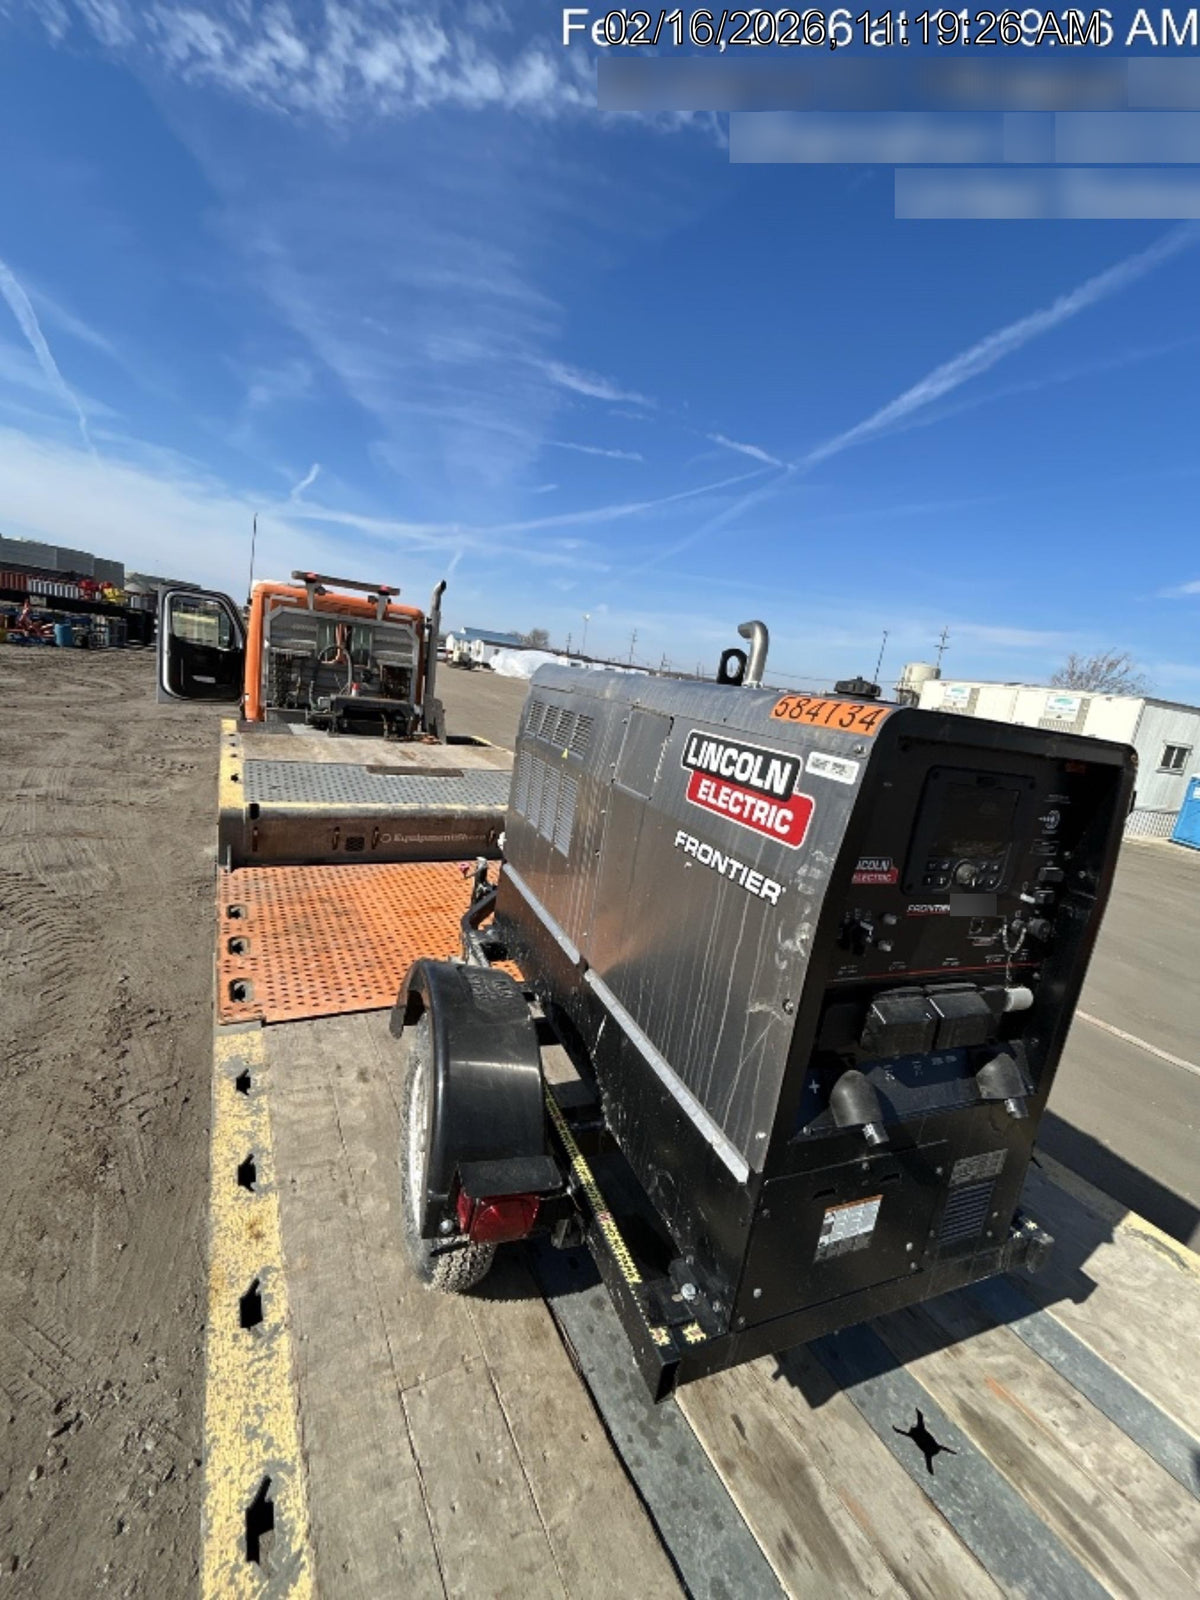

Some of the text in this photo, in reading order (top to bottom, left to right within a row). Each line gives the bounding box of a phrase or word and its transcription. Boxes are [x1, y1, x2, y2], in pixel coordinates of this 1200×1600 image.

[686, 738, 792, 795] LINCOLN
[697, 779, 794, 834] ELECTRIC
[674, 829, 783, 905] FRONTIER
